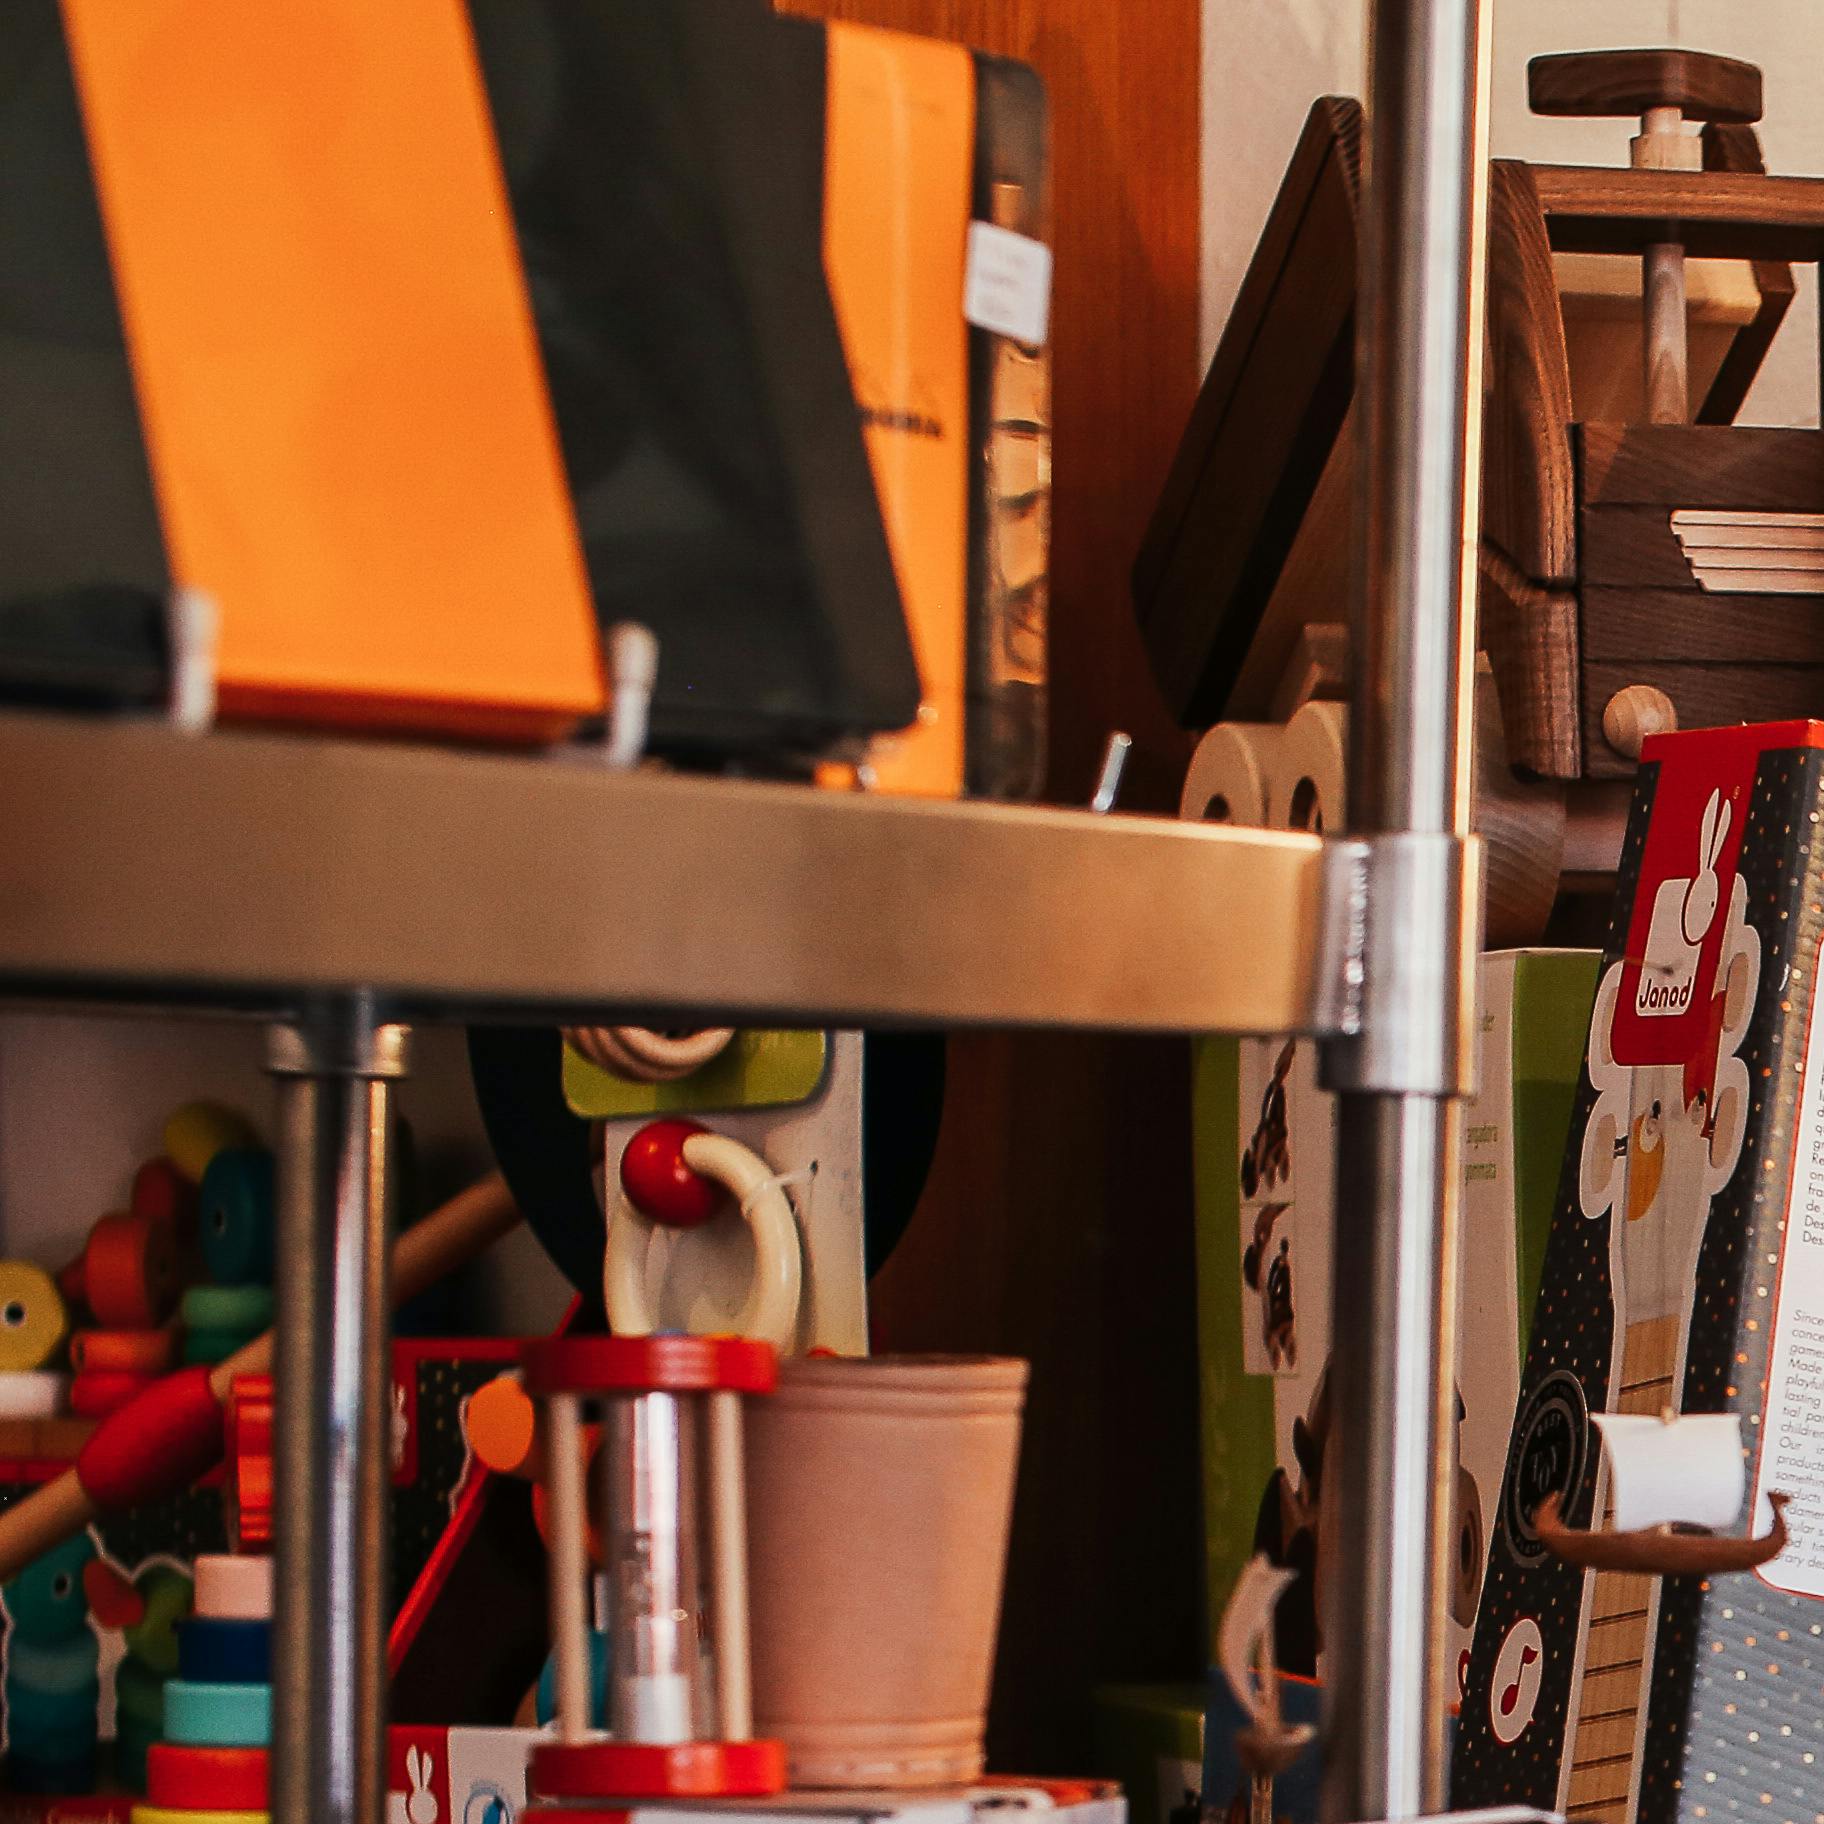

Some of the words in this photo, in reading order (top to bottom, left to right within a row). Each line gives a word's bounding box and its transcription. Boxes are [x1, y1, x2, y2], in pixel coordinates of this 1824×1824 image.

[1639, 975, 1693, 1010] Janod
[1806, 1200, 1820, 1213] de
[1804, 1215, 1824, 1231] Des
[1793, 1309, 1824, 1327] Since
